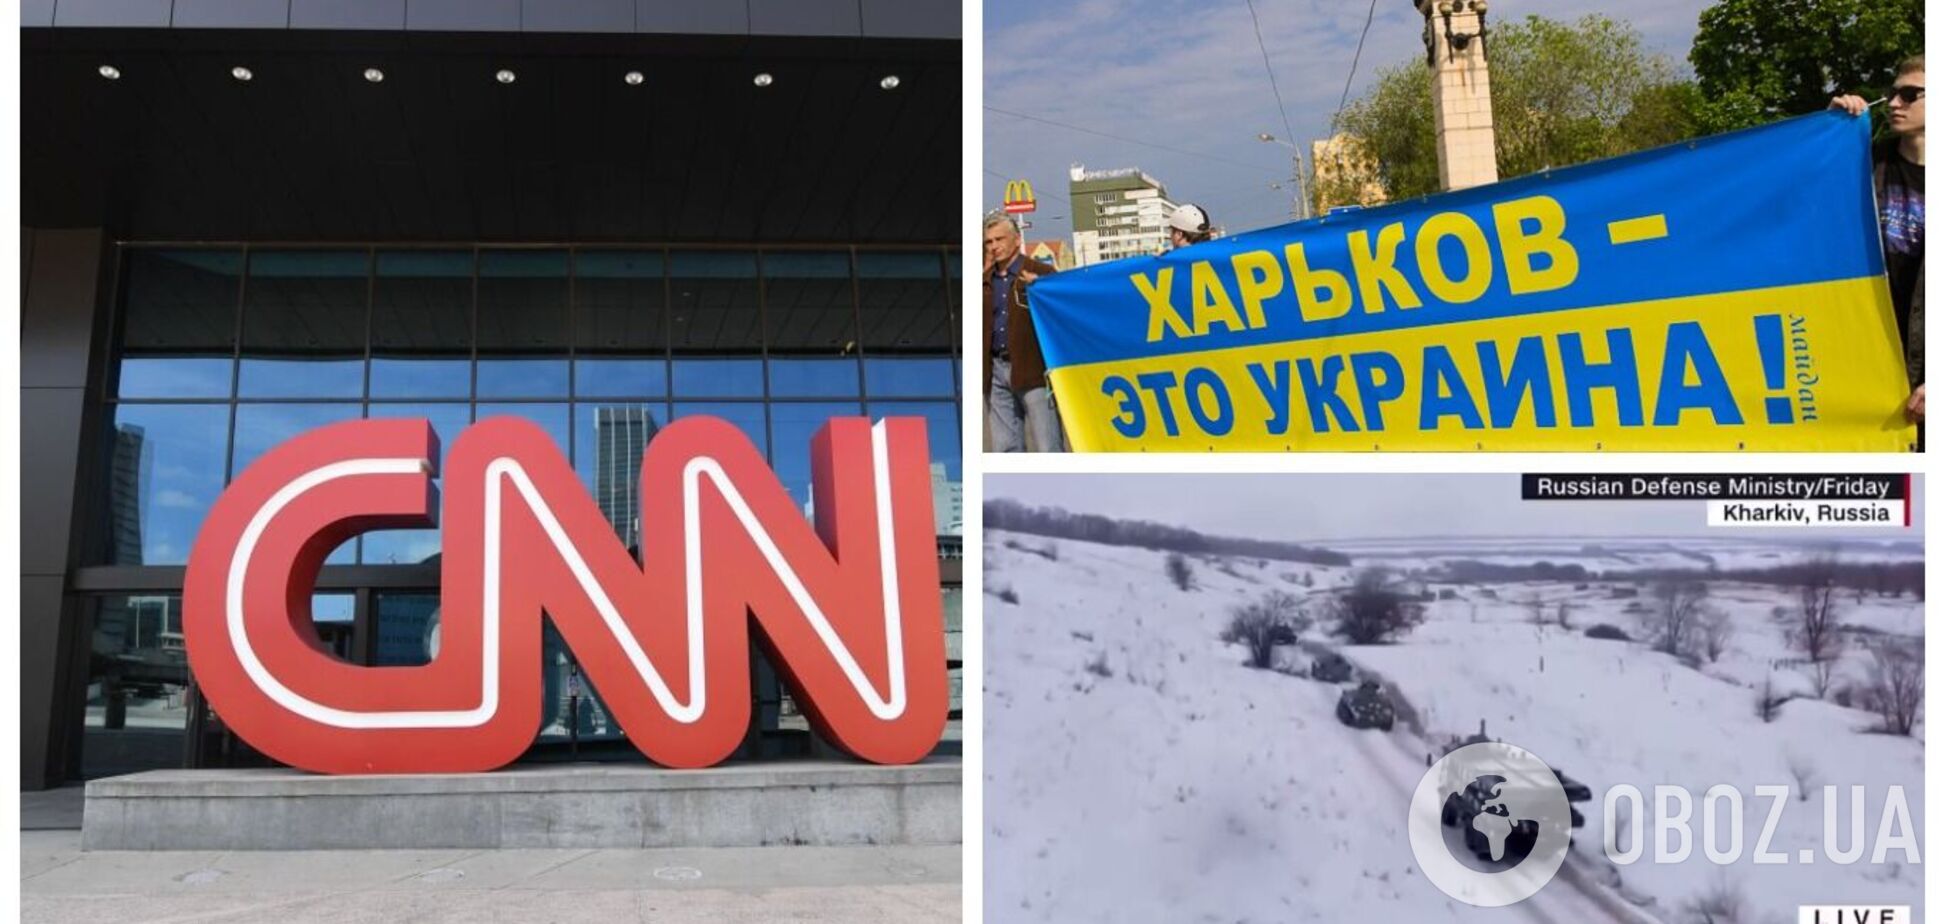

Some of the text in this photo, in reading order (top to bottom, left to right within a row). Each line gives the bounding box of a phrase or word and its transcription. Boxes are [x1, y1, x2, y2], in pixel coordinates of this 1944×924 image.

[1130, 195, 1580, 343] ХАРЬКОВ
[1101, 367, 1235, 439] ЭТО
[182, 414, 949, 776] CNN
